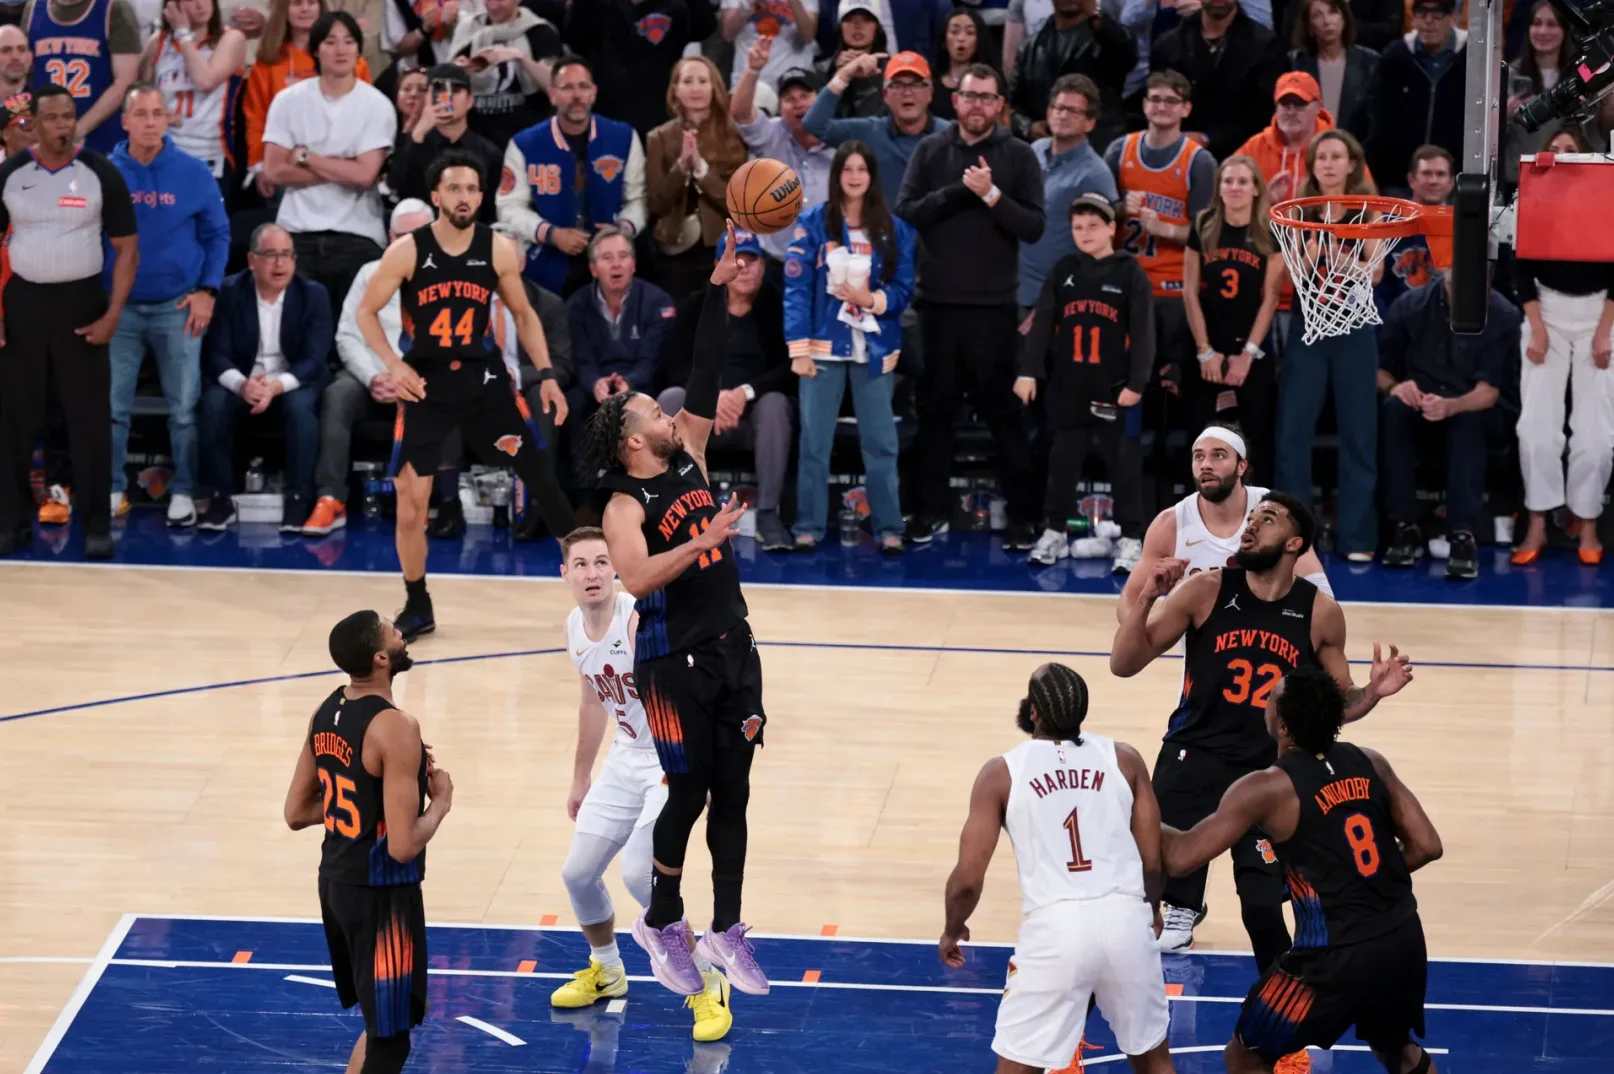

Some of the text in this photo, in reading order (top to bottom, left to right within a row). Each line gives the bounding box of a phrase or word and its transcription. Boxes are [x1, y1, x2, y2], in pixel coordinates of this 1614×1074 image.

[45, 58, 91, 97] 32
[528, 163, 561, 195] 46
[1123, 219, 1157, 257] 21
[417, 280, 490, 307] NEW YORK
[1220, 268, 1240, 299] 3
[429, 307, 476, 348] 44
[1063, 300, 1118, 323] NEW YORK
[1072, 325, 1101, 364] 11
[658, 498, 688, 542] NEW
[1214, 629, 1300, 669] NEW YORK
[1223, 658, 1283, 710] 32
[615, 707, 637, 740] 5
[313, 732, 353, 768] BRIDGES
[318, 767, 361, 840] 25
[1029, 769, 1105, 799] HARDEN
[1314, 777, 1371, 816] ANUNOBY
[1063, 806, 1092, 872] 1
[1344, 813, 1380, 877] 8
